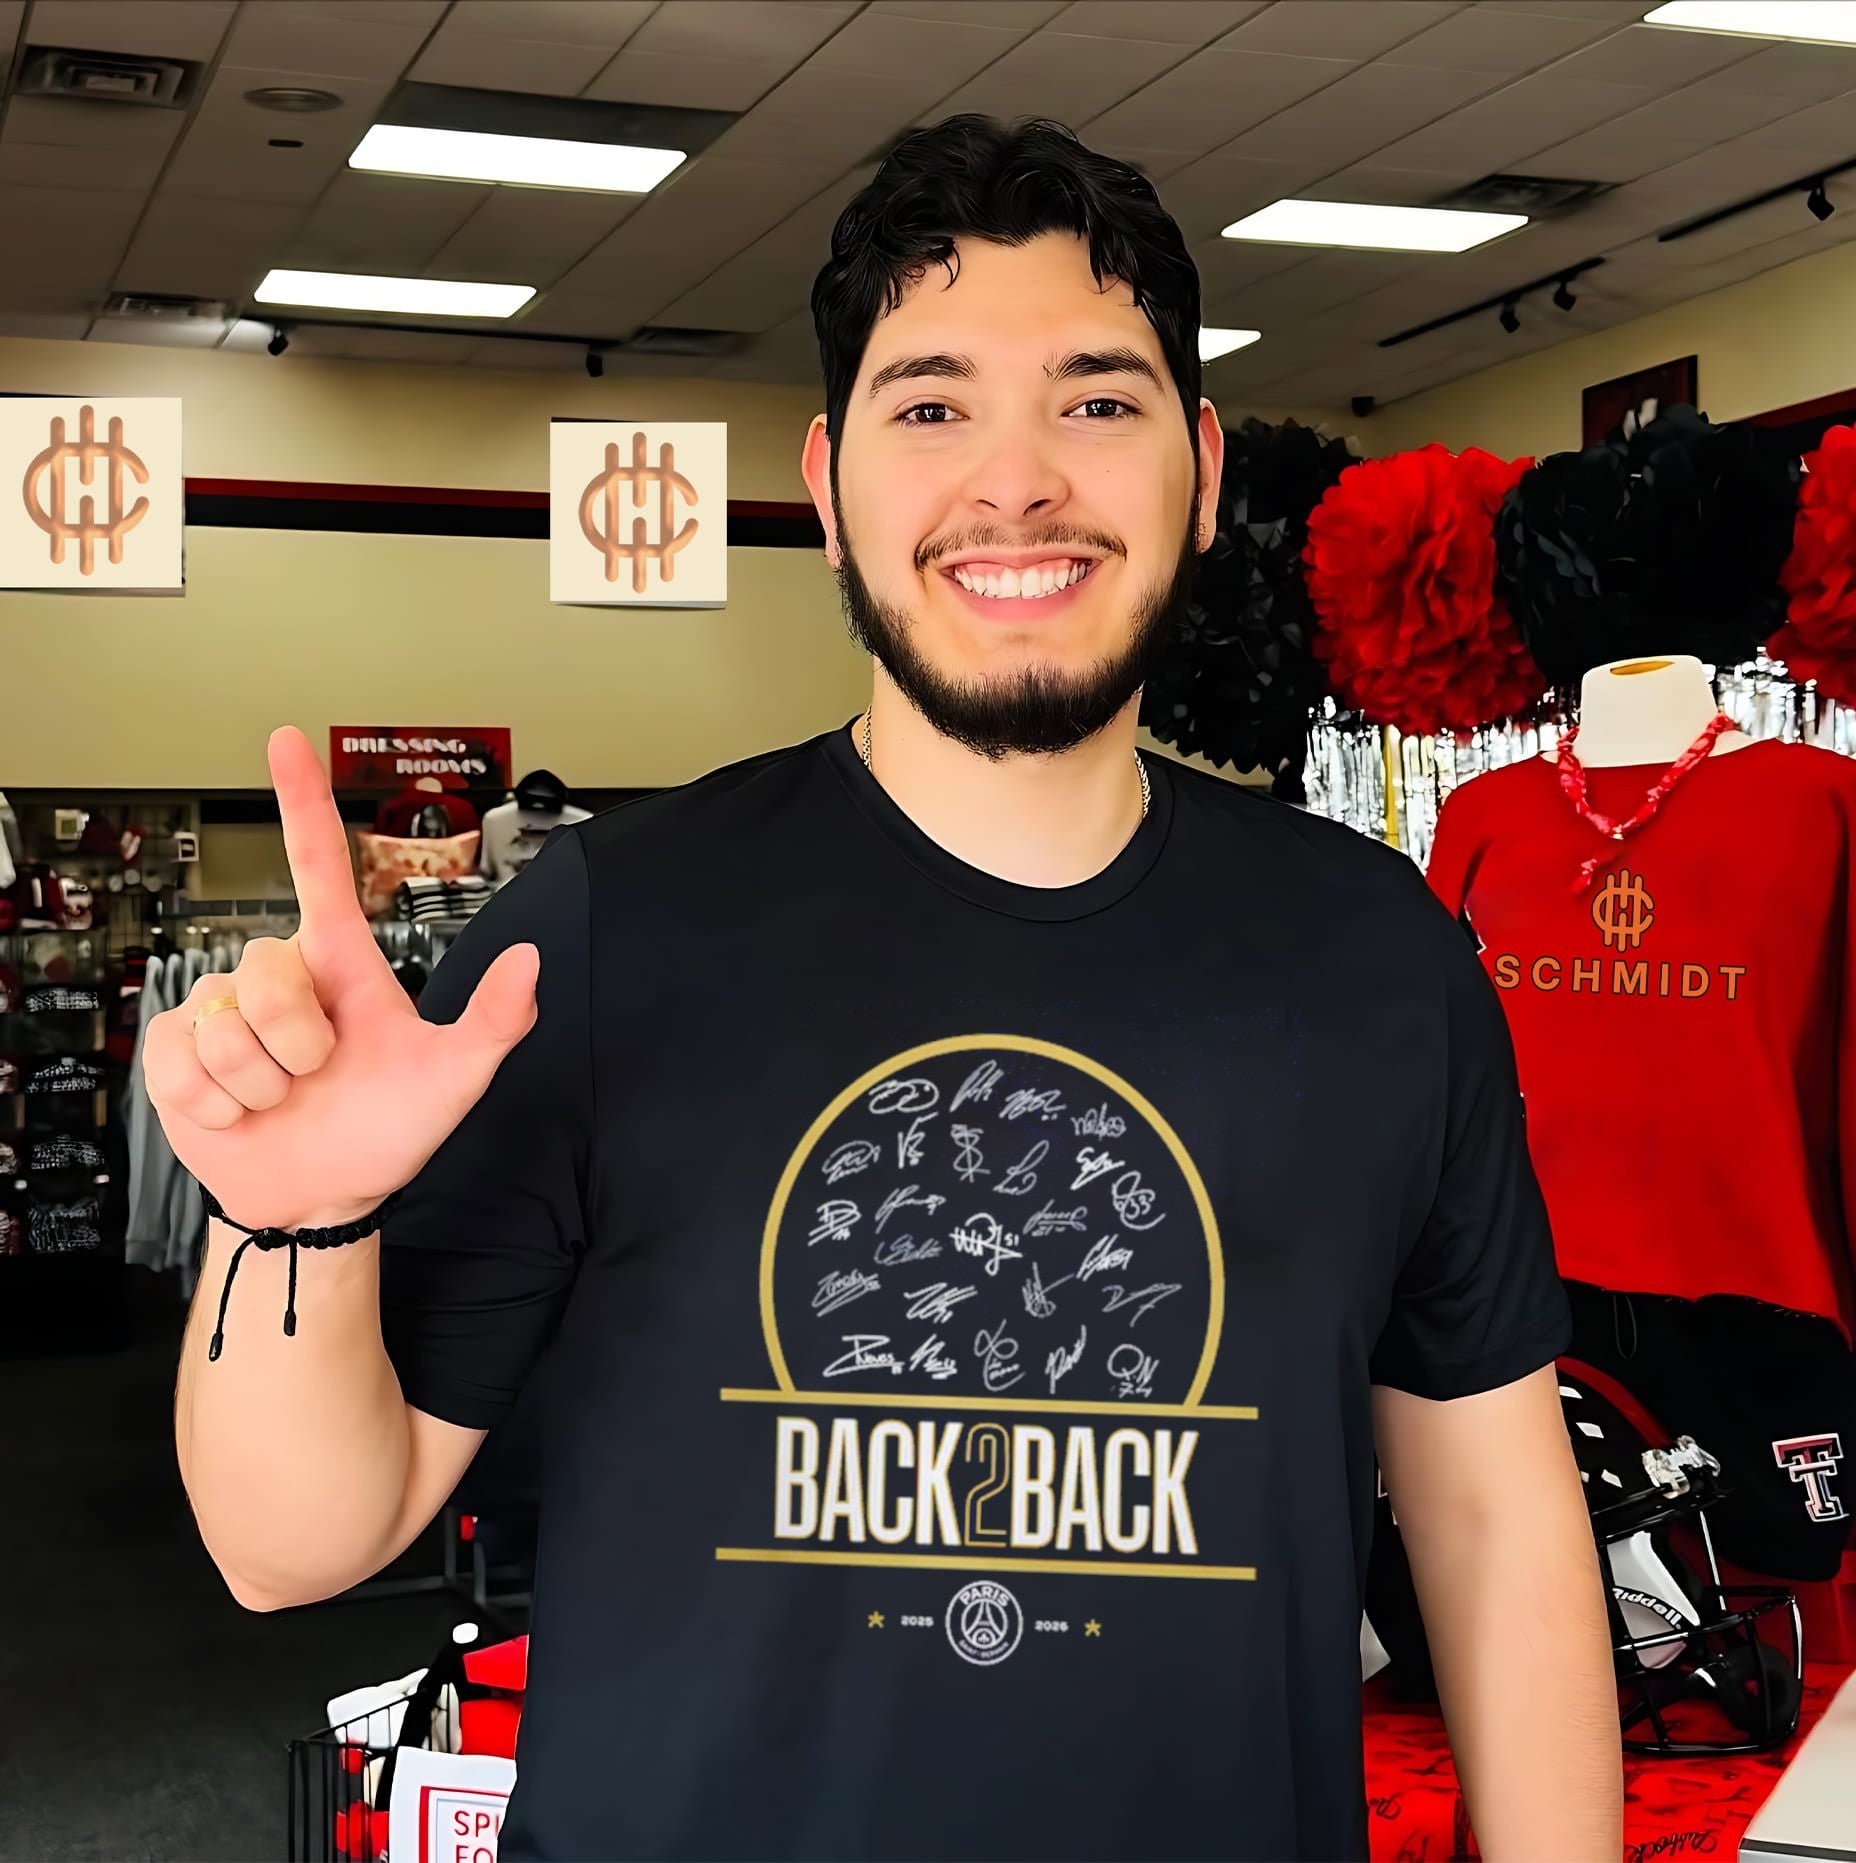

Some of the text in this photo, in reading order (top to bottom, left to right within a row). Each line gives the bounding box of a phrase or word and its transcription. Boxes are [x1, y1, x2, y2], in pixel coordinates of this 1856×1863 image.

[1494, 954, 1747, 1000] SCHMIDT
[774, 1416, 1199, 1555] BACK2BACK
[958, 1585, 1011, 1607] PARIS
[900, 1614, 1070, 1633] 2025 2026
